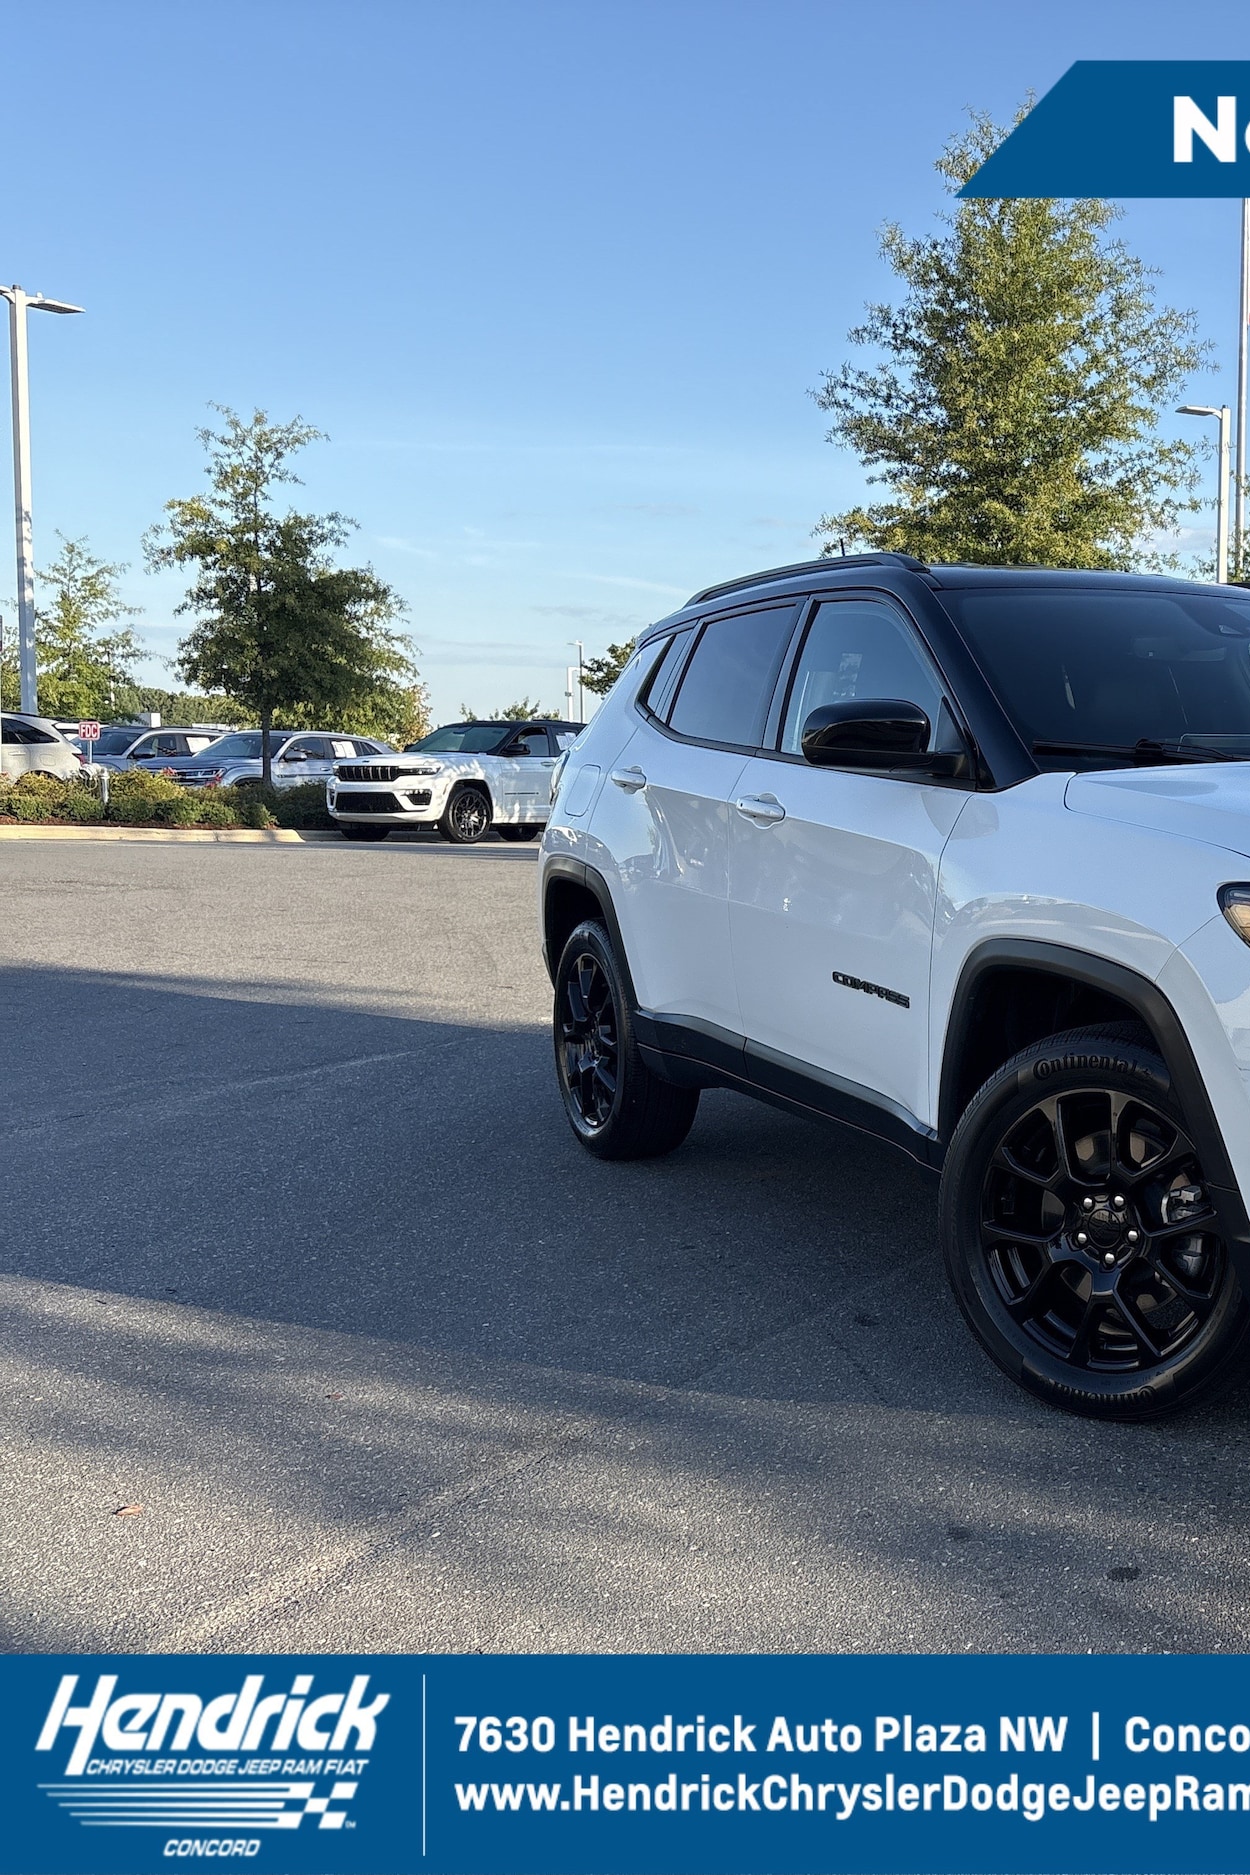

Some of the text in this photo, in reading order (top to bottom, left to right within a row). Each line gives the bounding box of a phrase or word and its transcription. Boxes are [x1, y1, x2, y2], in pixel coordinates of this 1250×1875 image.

[80, 724, 98, 738] FDC
[832, 971, 910, 1009] COMPASS
[1033, 1052, 1138, 1080] Continental
